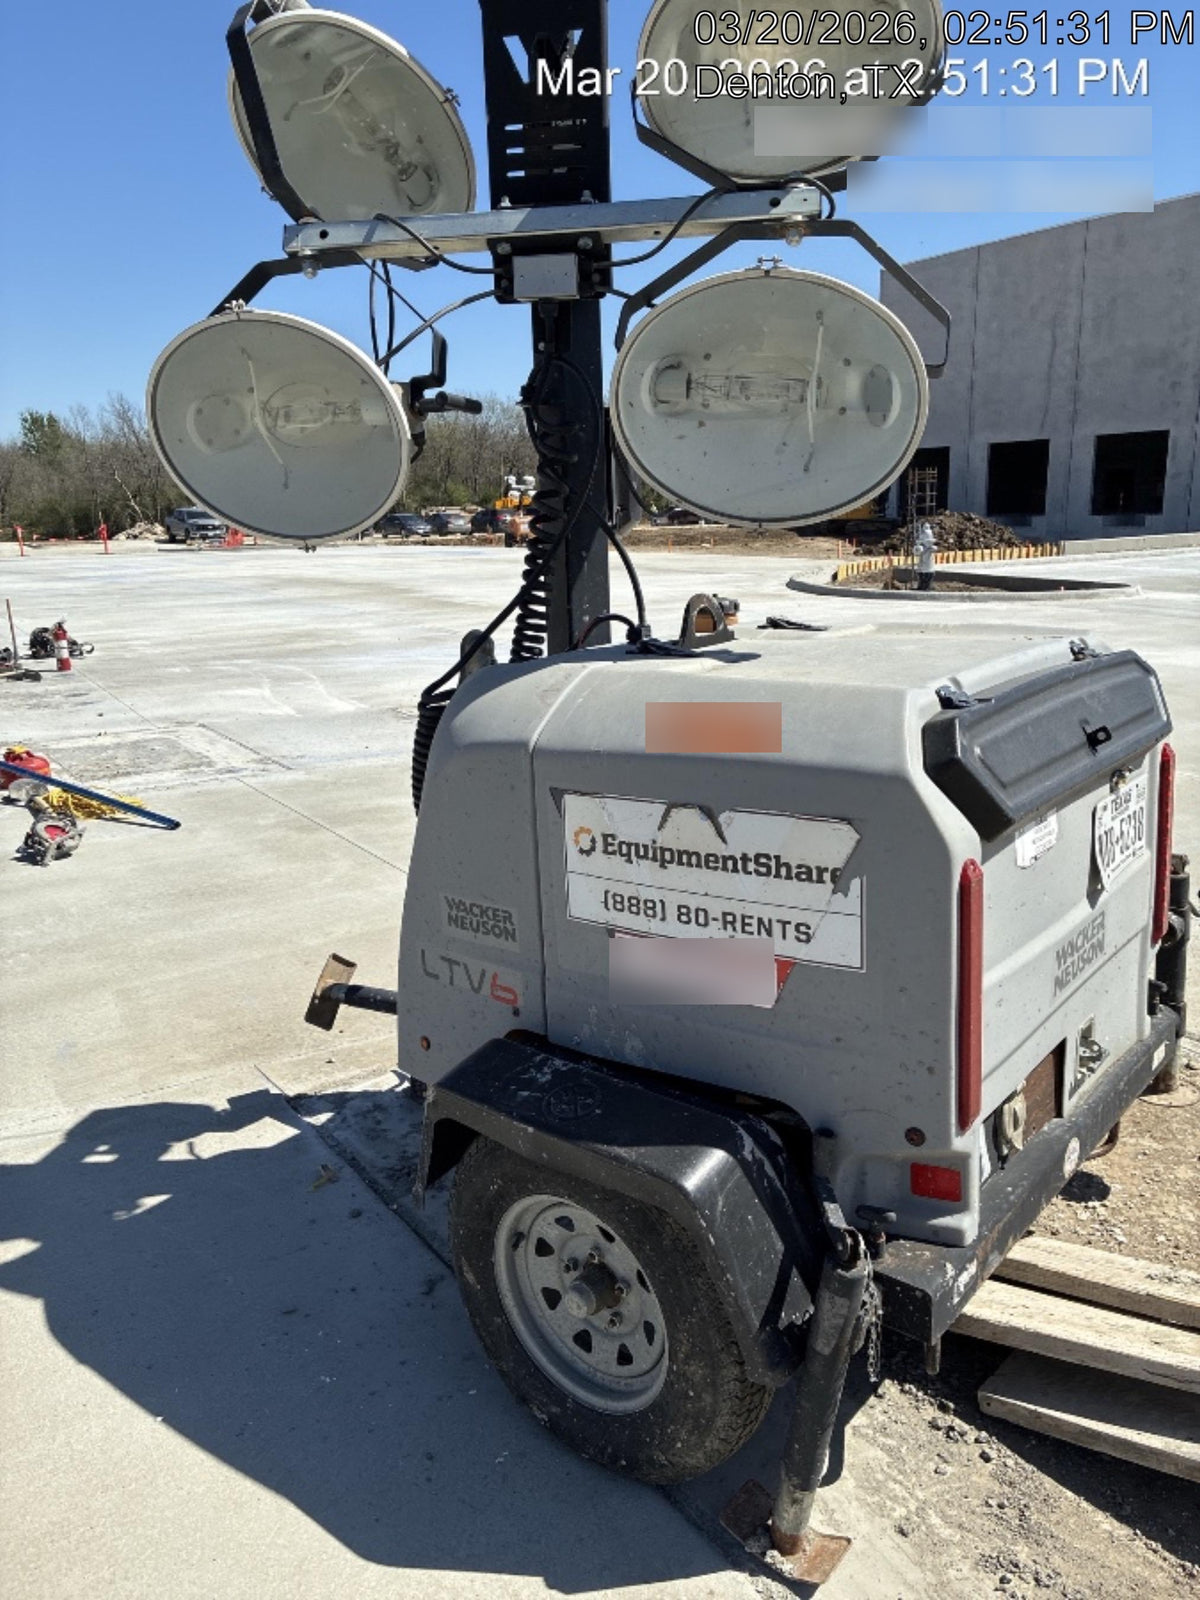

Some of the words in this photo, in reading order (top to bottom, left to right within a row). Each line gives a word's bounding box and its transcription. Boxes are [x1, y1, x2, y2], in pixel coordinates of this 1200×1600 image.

[444, 895, 515, 927] WACKER
[447, 911, 517, 943] NEUSON
[603, 889, 667, 922] (888)
[677, 904, 813, 944] 80-RENTS
[421, 948, 519, 1007] LTV6
